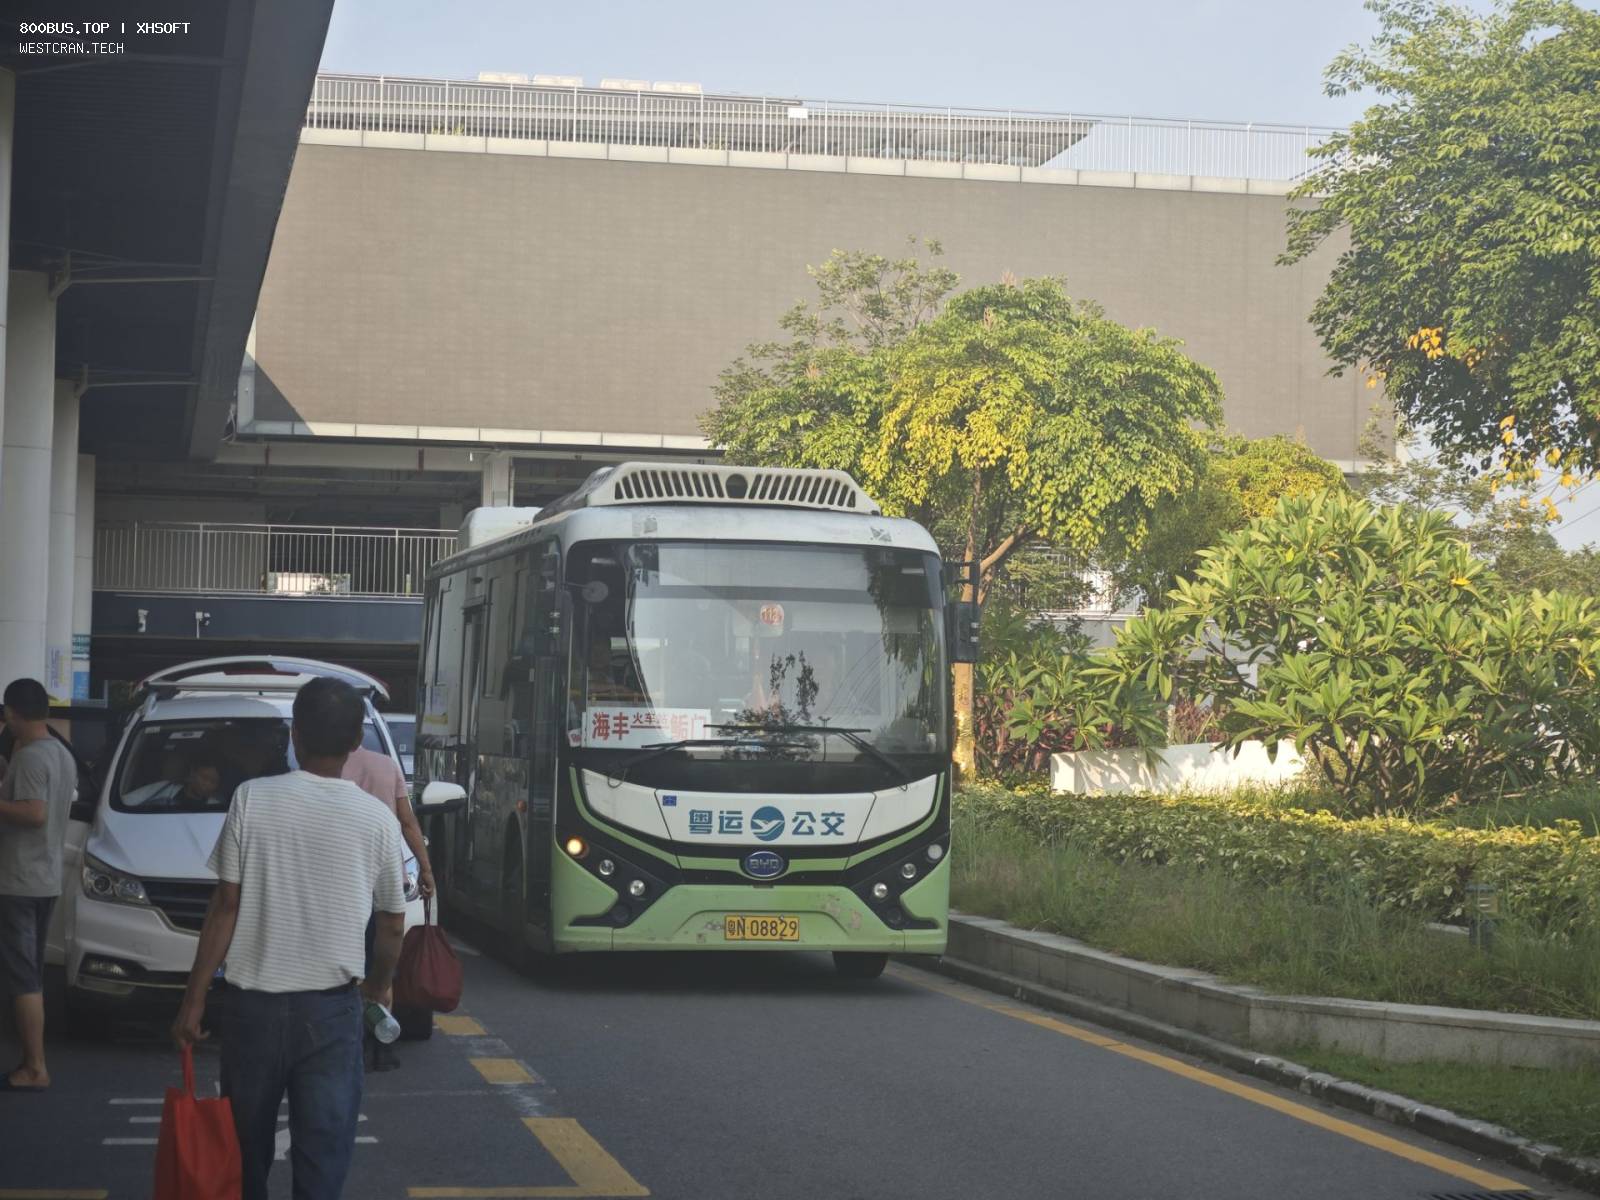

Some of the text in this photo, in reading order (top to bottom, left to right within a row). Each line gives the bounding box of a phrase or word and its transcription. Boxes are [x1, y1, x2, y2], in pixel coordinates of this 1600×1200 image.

[592, 711, 630, 741] 海丰
[688, 809, 845, 835] 粤运 公交
[750, 859, 779, 869] BYD
